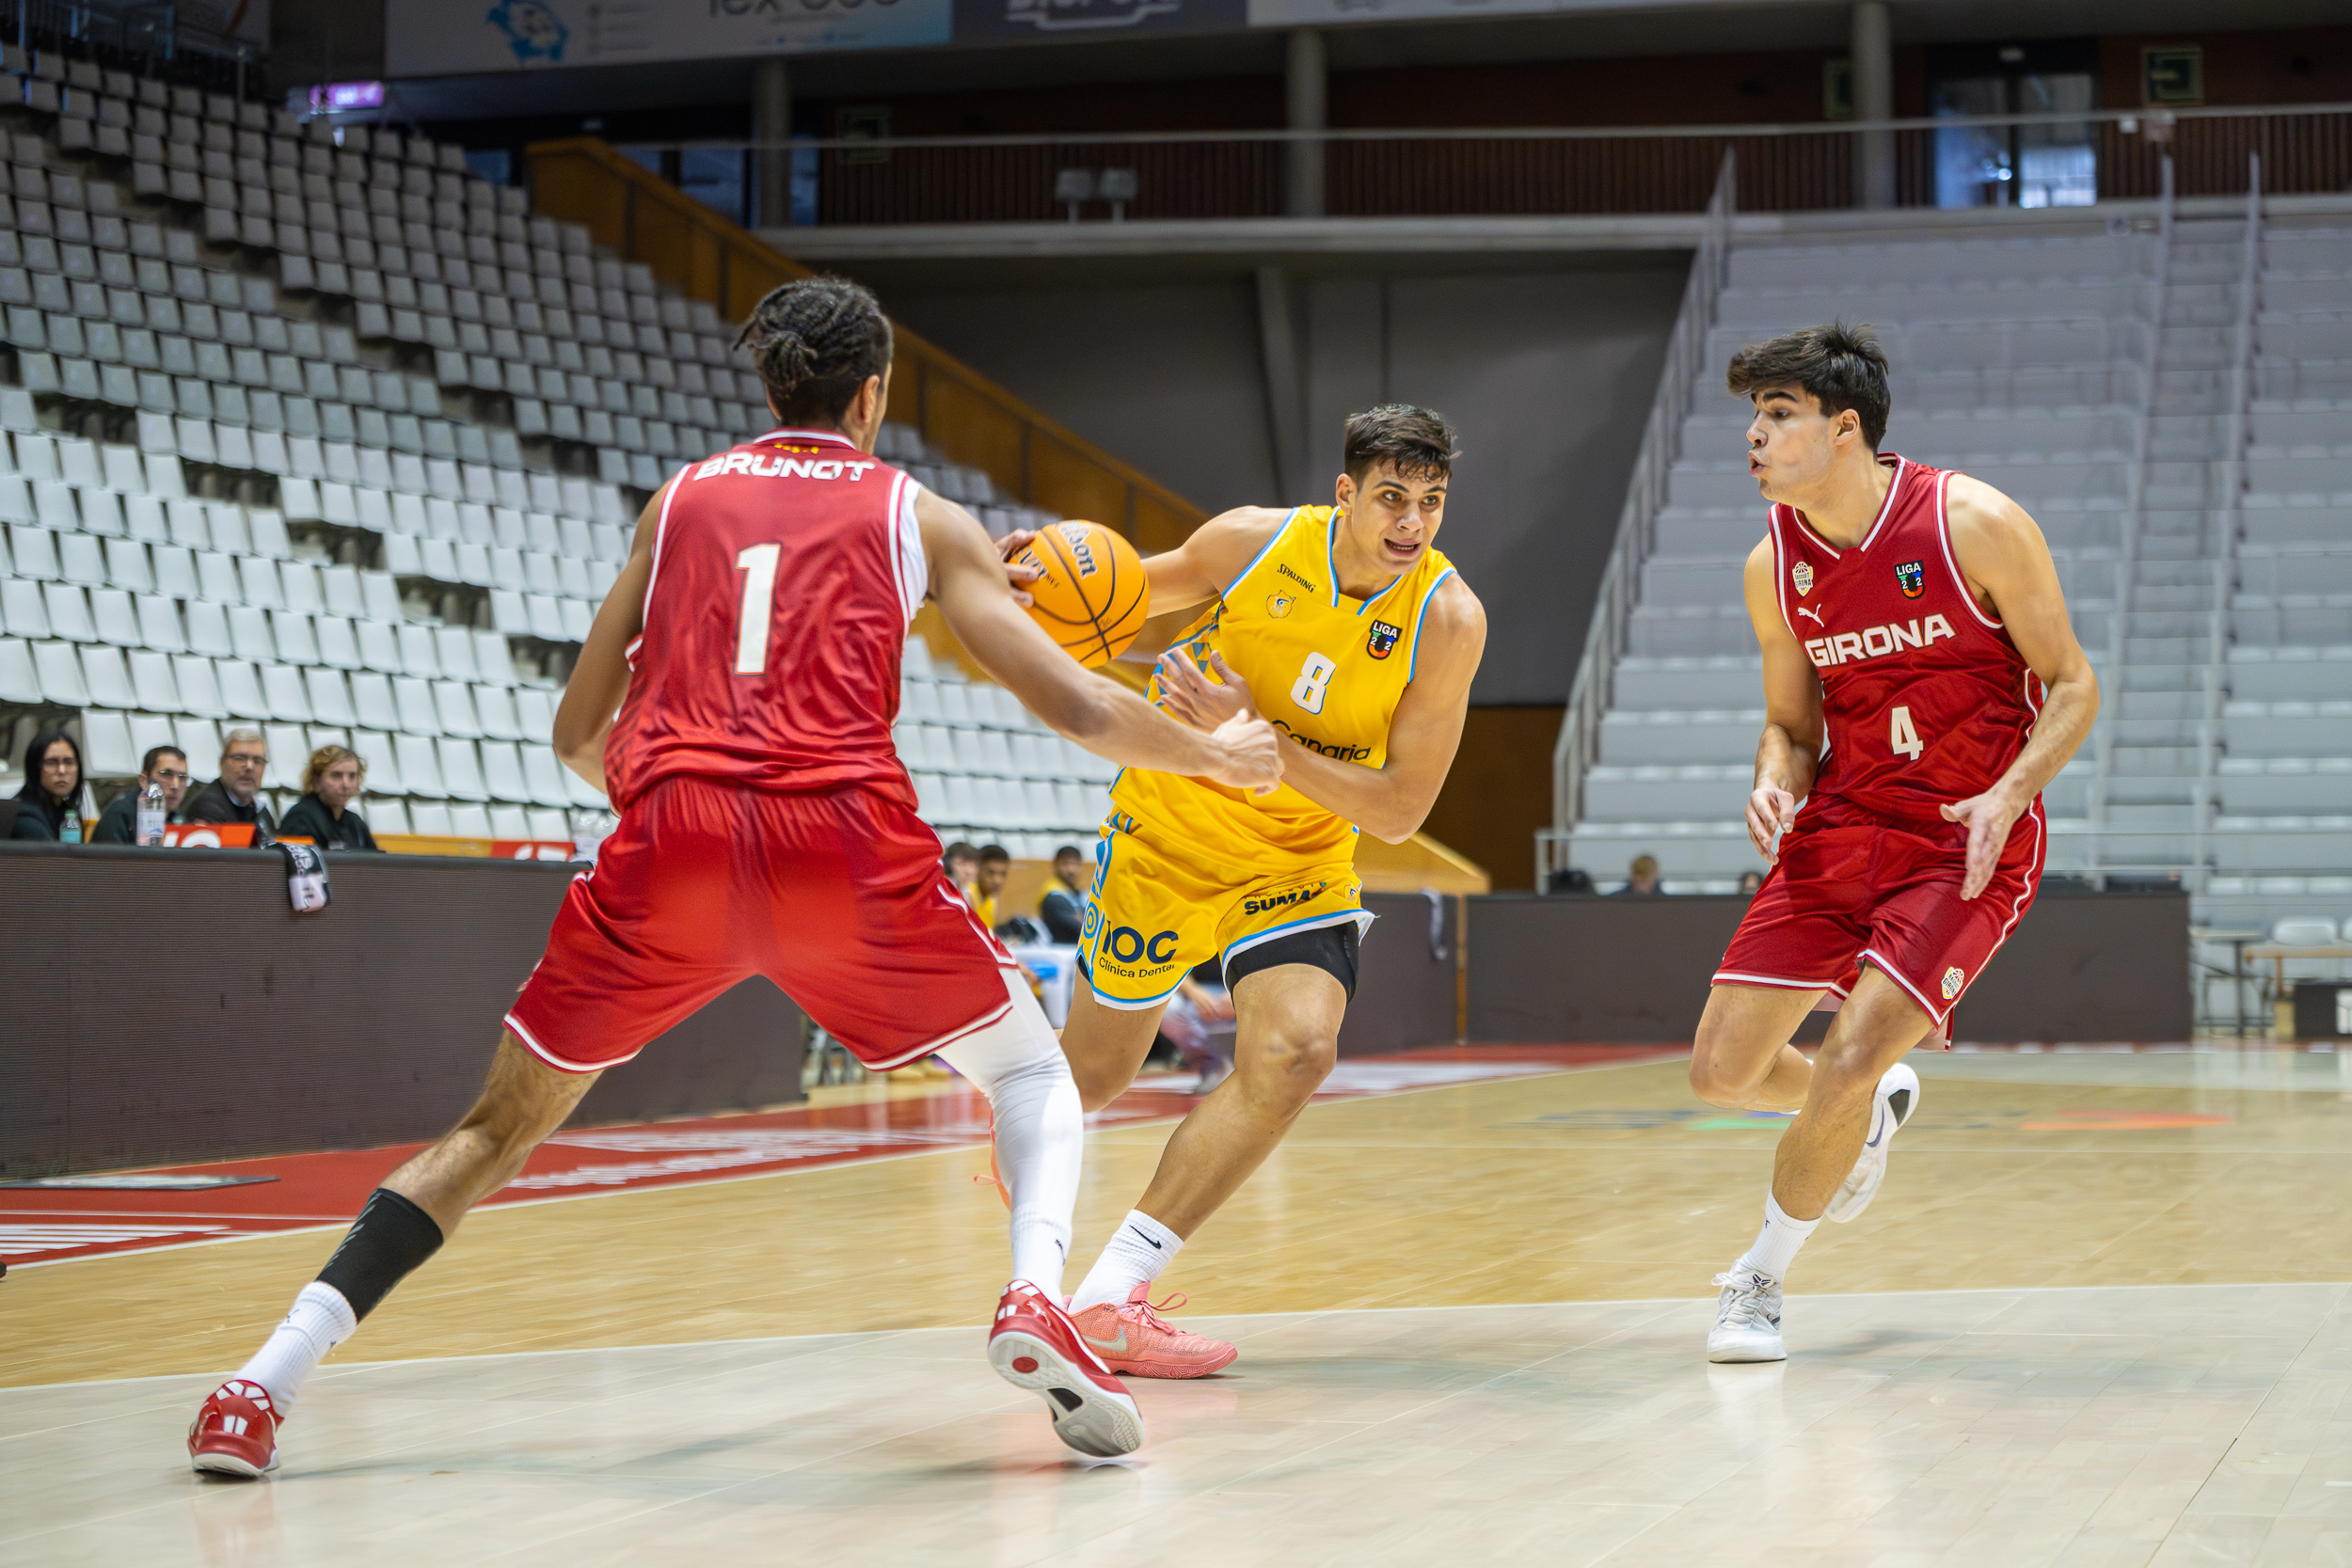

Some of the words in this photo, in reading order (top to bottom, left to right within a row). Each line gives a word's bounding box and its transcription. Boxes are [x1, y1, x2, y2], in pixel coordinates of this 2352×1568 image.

[692, 451, 876, 483] BRUNOT
[1277, 563, 1316, 594] SPALDING
[1896, 562, 1922, 576] LIGA
[734, 542, 782, 676] 1
[1373, 621, 1398, 639] LIGA
[1804, 612, 1958, 668] GIRONA
[1290, 652, 1337, 715] 8
[1890, 705, 1924, 761] 4
[1102, 919, 1179, 965] IOC
[1099, 957, 1135, 978] Clínica
